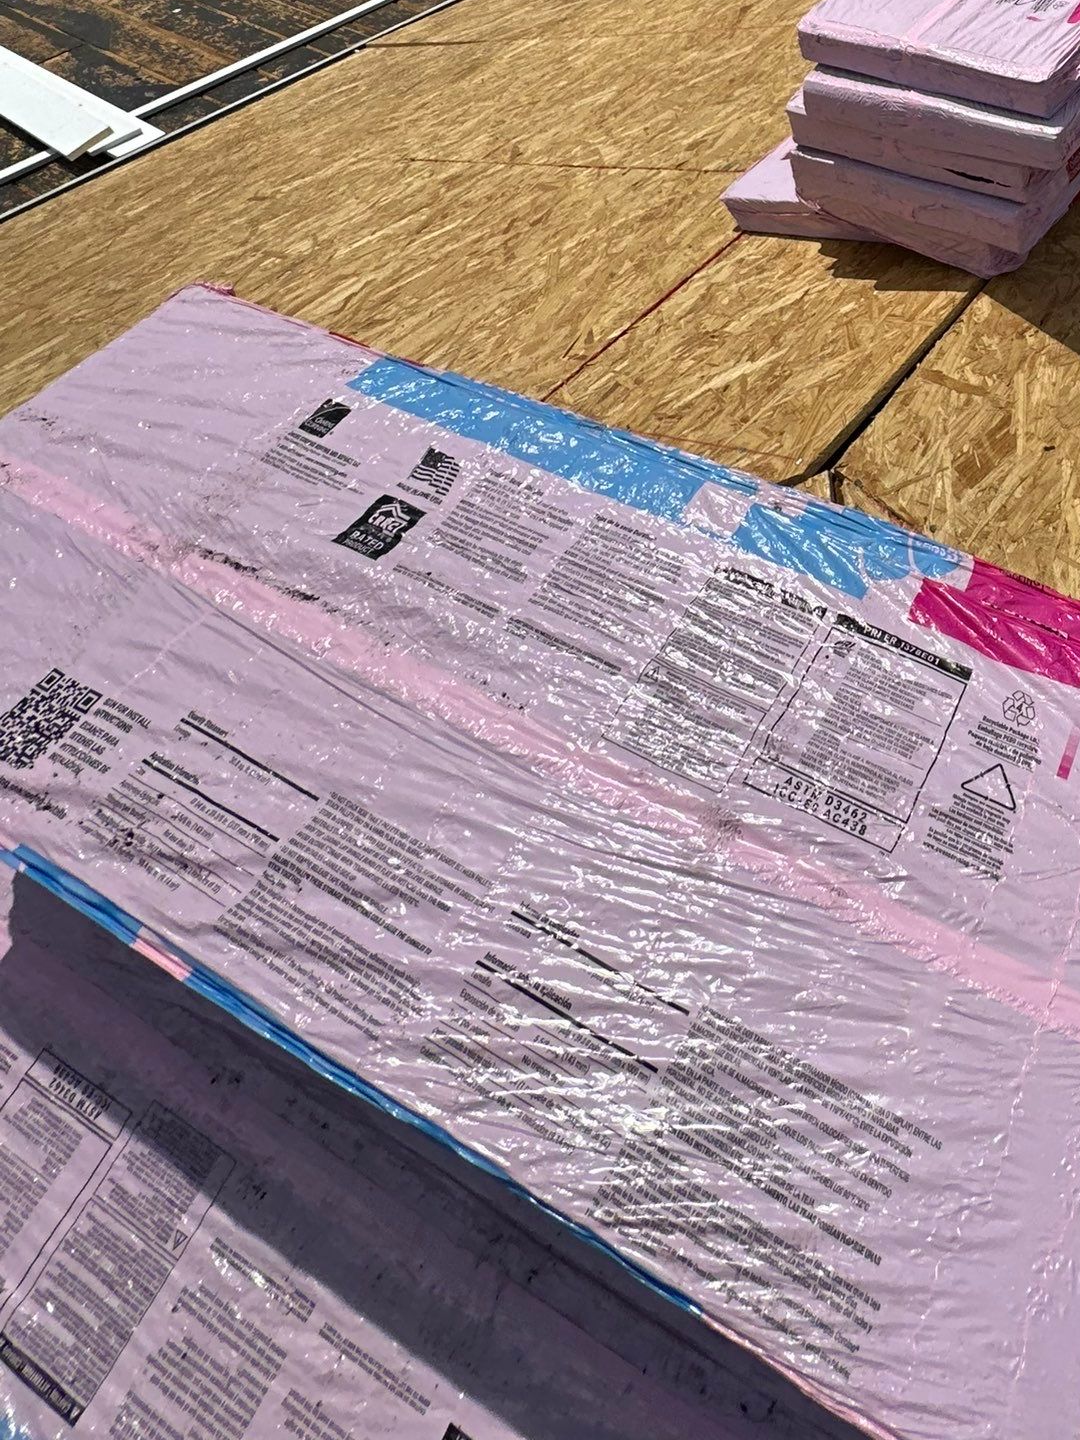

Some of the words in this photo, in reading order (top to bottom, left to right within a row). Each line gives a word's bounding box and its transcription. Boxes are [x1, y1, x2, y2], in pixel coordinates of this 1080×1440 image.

[350, 530, 385, 551] RATED
[125, 710, 150, 728] INSTALL
[100, 732, 119, 746] PARA
[149, 752, 174, 769] Application
[824, 791, 869, 823] D3462
[460, 989, 488, 1010] Exposición
[76, 1099, 103, 1121] ASTM
[912, 1126, 931, 1143] ENTRE
